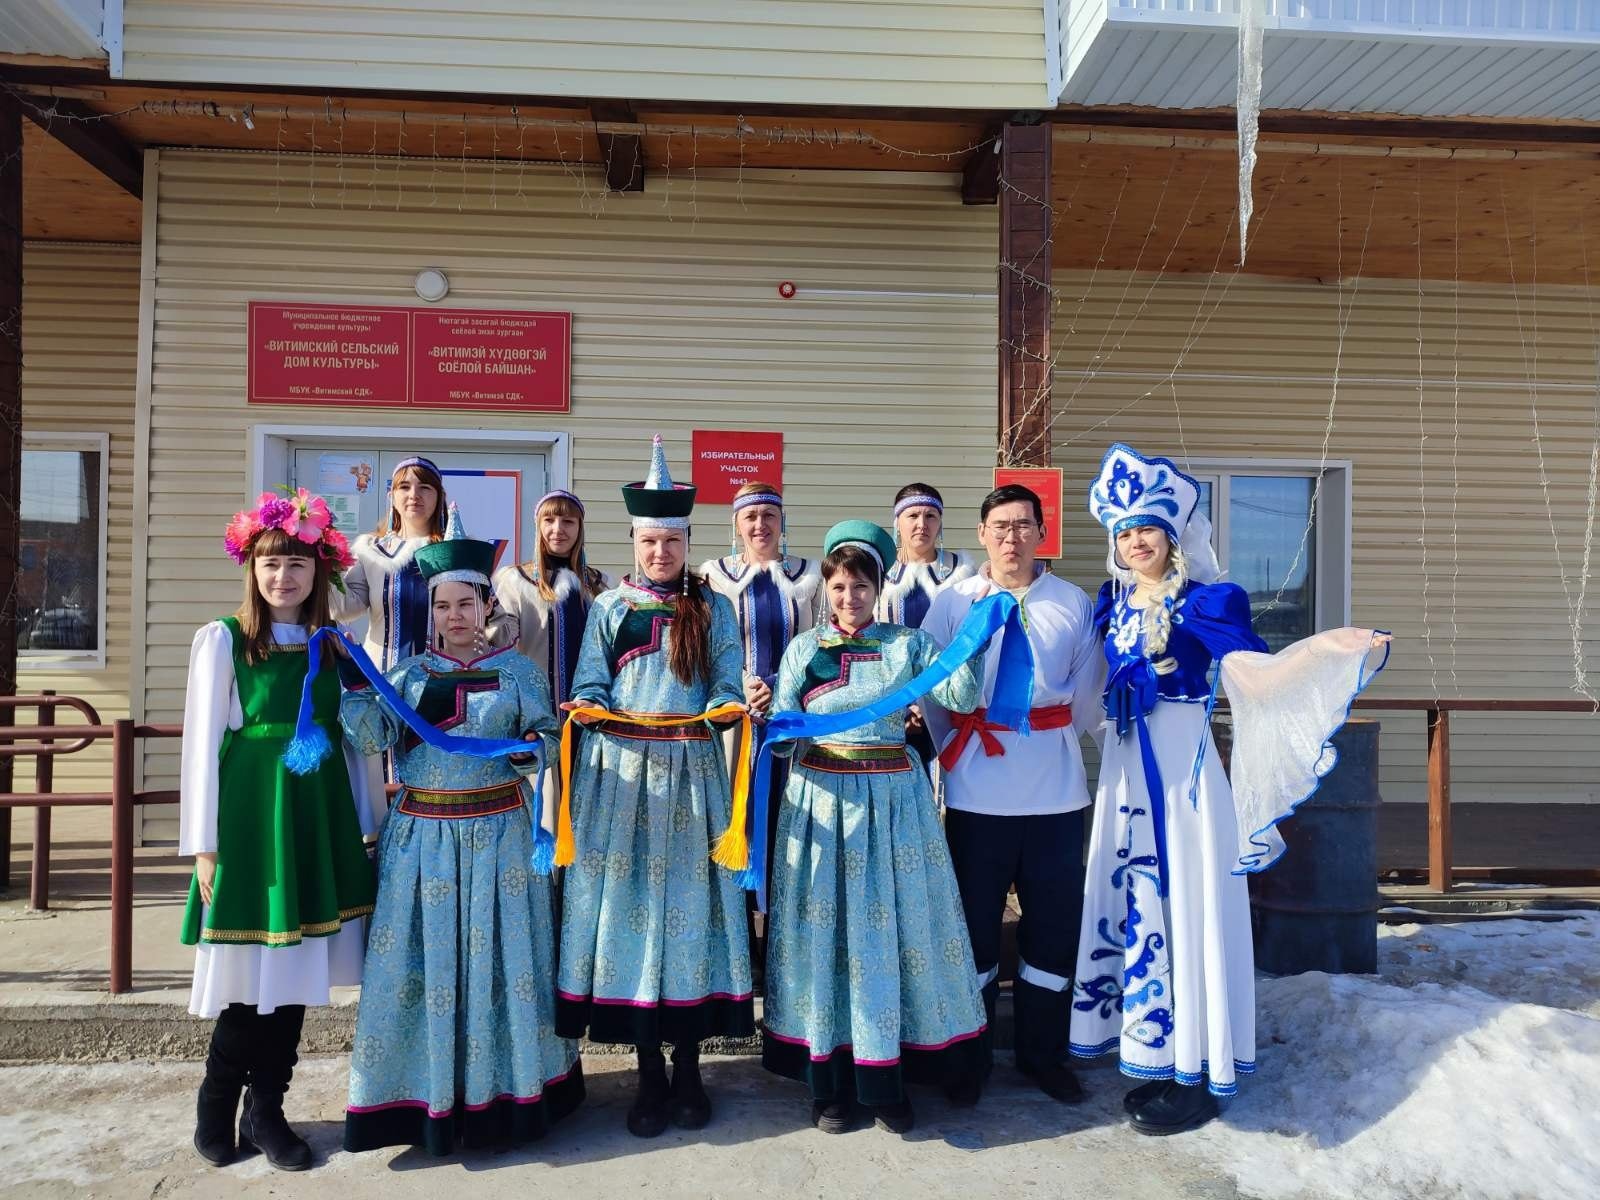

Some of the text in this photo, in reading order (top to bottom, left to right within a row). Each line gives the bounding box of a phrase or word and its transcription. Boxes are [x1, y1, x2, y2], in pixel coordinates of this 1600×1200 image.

[337, 324, 371, 332] культуры
[264, 339, 399, 355] «ВИТИМСКИЙ СЕЛЬСКИЙ
[428, 345, 486, 359] «ВИТИМЭЙ
[284, 356, 380, 370] ДОМ КУЛЬТУРЫ»
[438, 360, 537, 375] СОЁЛОЙ БАЙШАН»
[289, 386, 310, 394] МБУК
[354, 387, 373, 397] СДК»
[449, 391, 470, 399] МБУК
[506, 392, 524, 401] СДК»
[701, 451, 775, 461] ИЗБИРАТЕЛЬНЫЙ
[720, 465, 759, 473] УЧАСТОК
